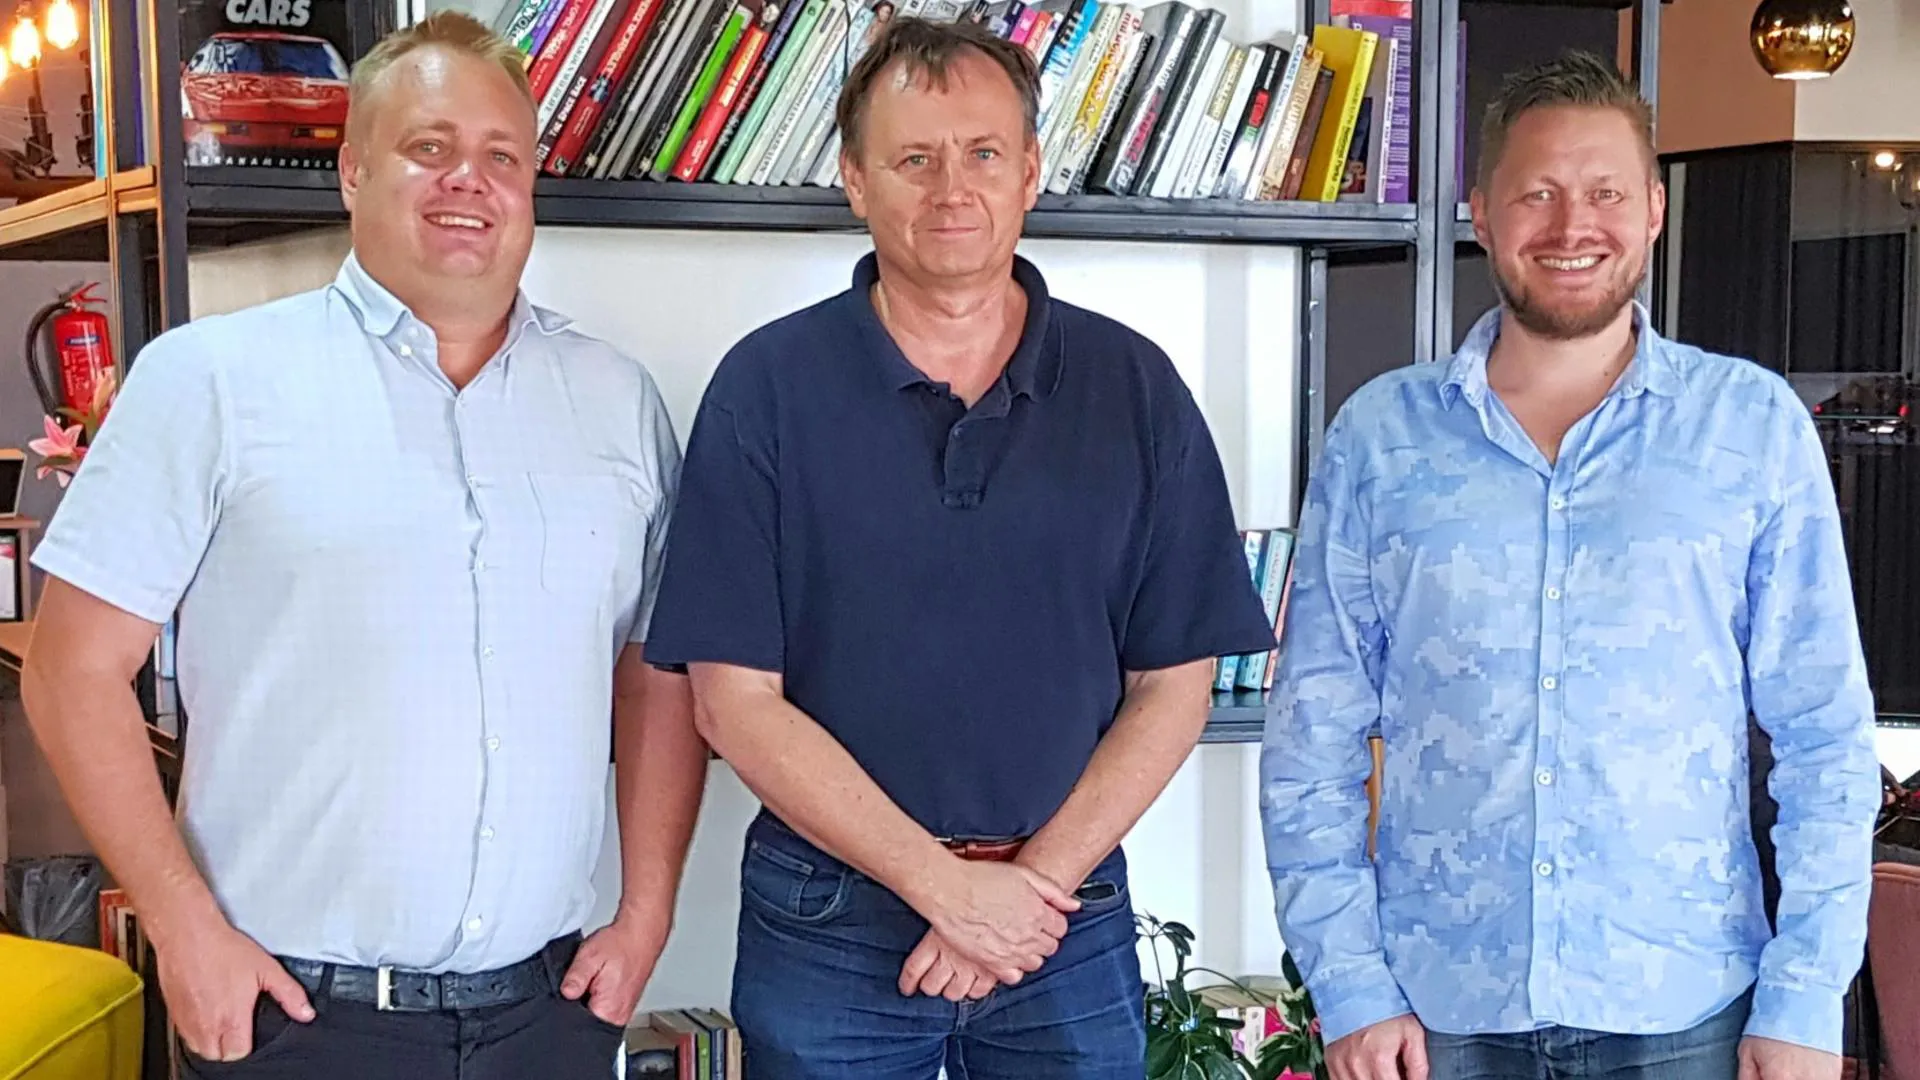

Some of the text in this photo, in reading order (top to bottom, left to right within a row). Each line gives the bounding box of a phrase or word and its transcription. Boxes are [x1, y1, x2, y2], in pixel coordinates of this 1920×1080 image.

[226, 0, 312, 27] CARS
[557, 96, 576, 123] SPACE
[569, 75, 588, 98] RACE
